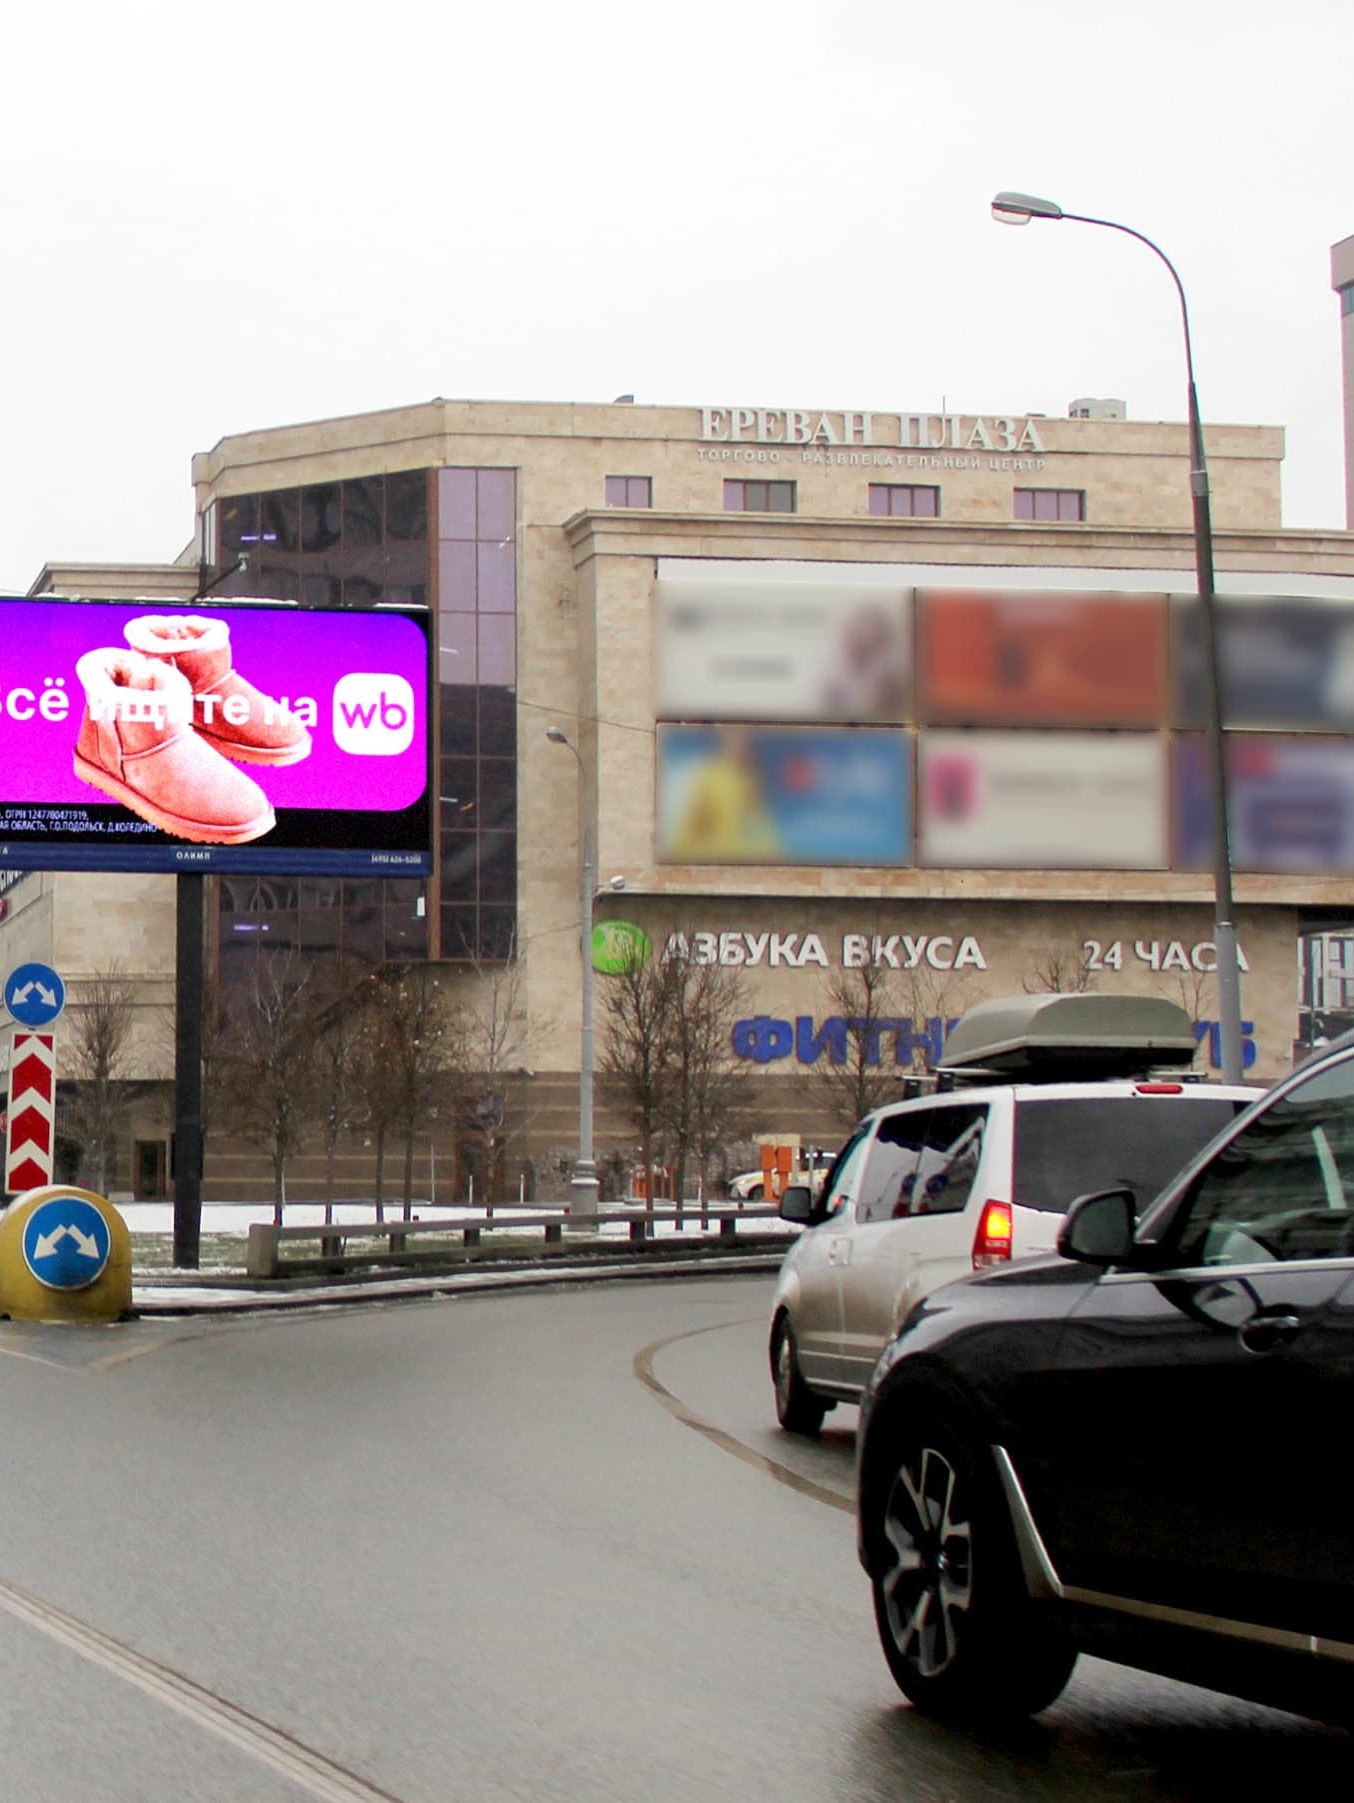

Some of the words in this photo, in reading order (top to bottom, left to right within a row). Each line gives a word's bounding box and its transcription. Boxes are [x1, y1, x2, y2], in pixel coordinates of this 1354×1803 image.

[701, 407, 872, 445] ЕРЕВАН
[898, 414, 1046, 451] ПЛАЗА
[697, 449, 781, 463] ТОРГОВО
[989, 457, 1046, 472] ЦЕНТР
[340, 690, 408, 731] wb
[5, 809, 26, 819] ОГРН
[176, 851, 211, 861] ОЛИМП
[661, 931, 830, 967] АЗБУКА
[843, 934, 988, 969] ВКУСА
[1083, 940, 1122, 970] 24
[732, 1015, 960, 1065] ФИТН
